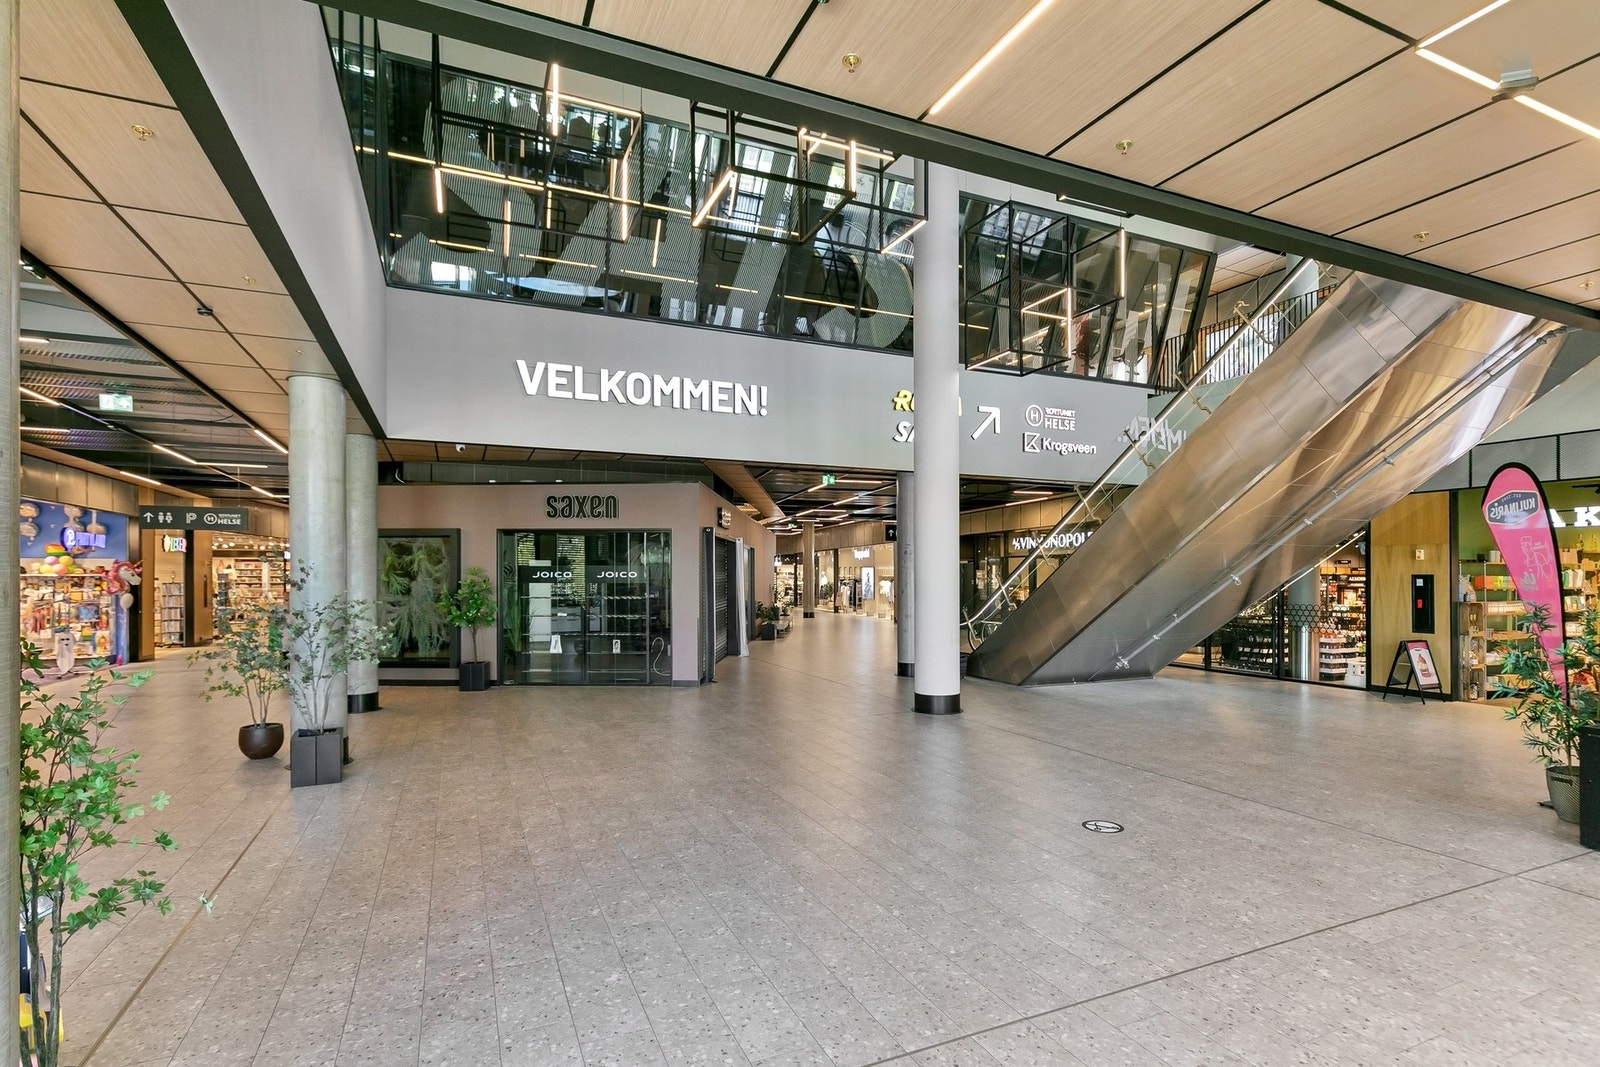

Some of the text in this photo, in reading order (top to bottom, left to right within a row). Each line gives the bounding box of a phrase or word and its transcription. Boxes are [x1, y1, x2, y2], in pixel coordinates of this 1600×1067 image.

[515, 359, 768, 417] VELKOMMEN!
[1044, 418, 1076, 431] HELSE
[1041, 437, 1097, 456] Krogsveen
[546, 495, 619, 519] saxen
[532, 571, 638, 579] JOICO JOICO
